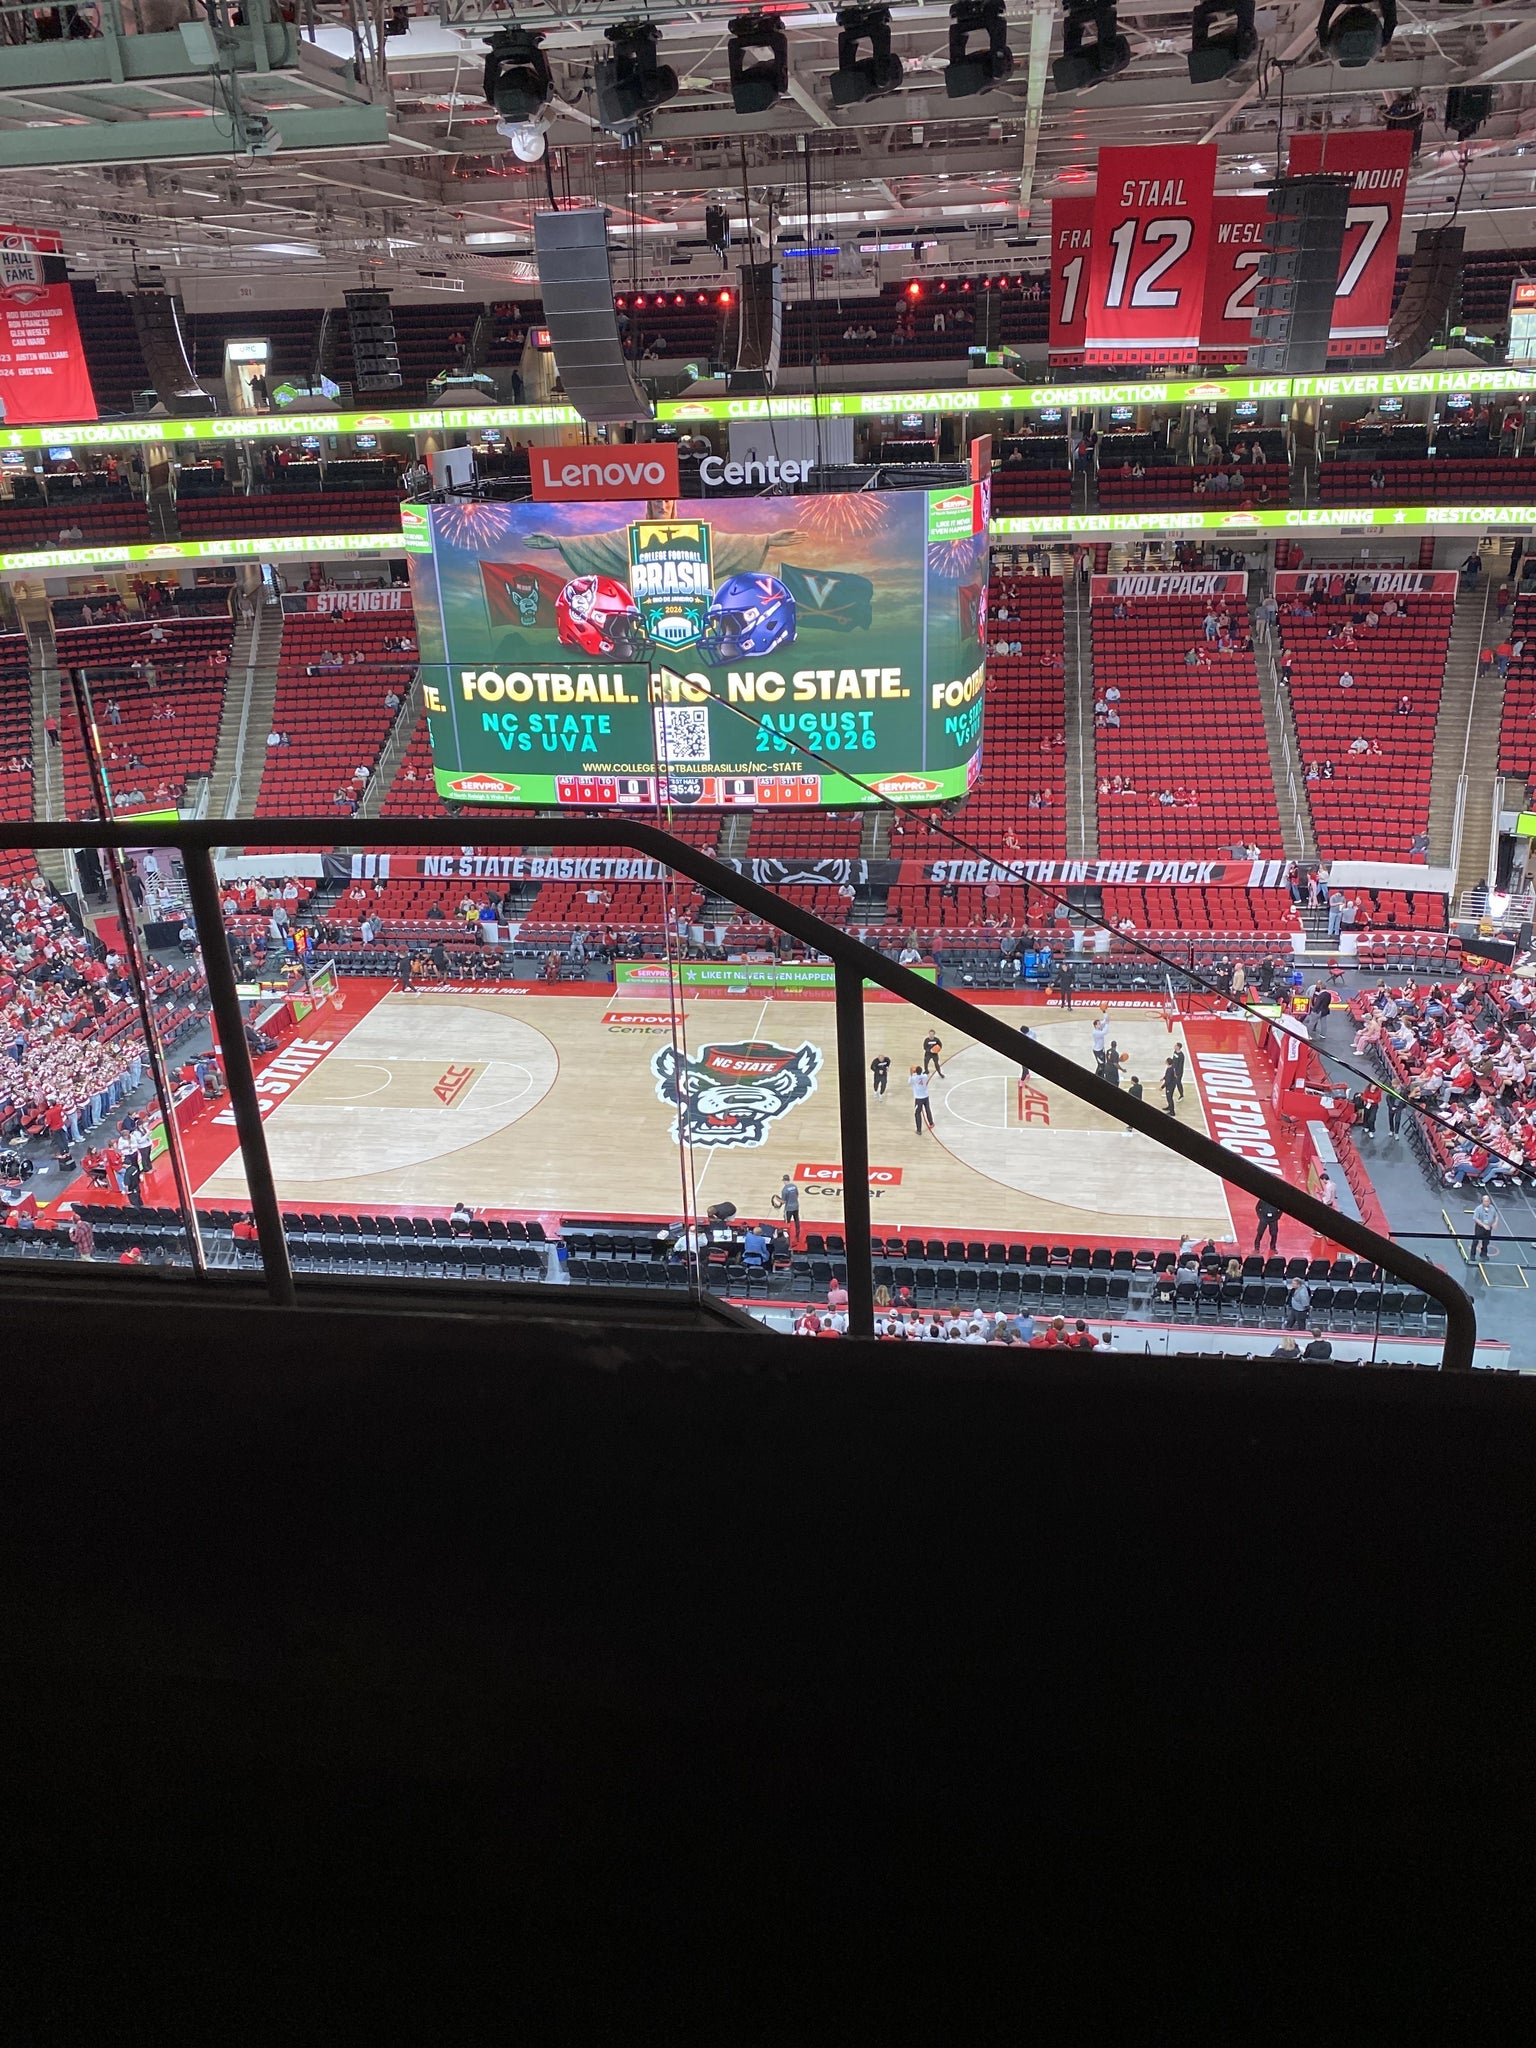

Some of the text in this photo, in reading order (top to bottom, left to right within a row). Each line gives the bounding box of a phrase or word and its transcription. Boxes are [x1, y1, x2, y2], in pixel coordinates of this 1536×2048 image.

[1120, 180, 1187, 207] STAAL
[1058, 228, 1091, 249] FRA
[1218, 223, 1262, 243] WESL
[2, 252, 32, 265] HALL
[1334, 203, 1390, 297] 7
[1105, 217, 1194, 308] 12
[6, 268, 35, 283] FAME
[18, 368, 34, 376] ERIC
[34, 367, 54, 375] STAAL
[728, 399, 812, 416] CLEANING
[861, 393, 980, 412] RESTORATION
[1031, 385, 1168, 407] CONSTRUCTION
[1248, 380, 1289, 397] LIKE
[1294, 378, 1311, 395] IT
[1316, 377, 1378, 394] NEVER
[1383, 374, 1433, 392] EVEN
[1438, 369, 1536, 390] HAPPENE
[40, 424, 163, 445] RESTORATION
[212, 415, 339, 435] CONSTRUCTION
[410, 413, 442, 428] LIKE
[450, 411, 462, 427] IT
[467, 409, 519, 426] NEVER
[523, 406, 567, 424] EVEN
[543, 455, 814, 488] Lenovo Center
[1010, 517, 1064, 532] NEVER
[1068, 515, 1111, 530] EVEN
[1113, 513, 1204, 529] HAPPENED
[1286, 509, 1374, 525] CLEANING
[1426, 507, 1536, 523] RESTORATIO
[4, 547, 129, 570] CONSTRUCTION
[200, 541, 230, 556] LIKE
[232, 540, 246, 555] IT
[255, 538, 302, 553] NEVER
[305, 536, 345, 550] EVEN
[639, 550, 702, 563] COLLEGE FOOTBALL
[632, 561, 714, 598] BRASIL
[1115, 574, 1221, 597] WOLFPACK
[317, 590, 401, 612] STRENGTH
[461, 671, 639, 703] FOOTBALL.
[727, 671, 786, 702] NC
[792, 667, 911, 701] STATE.
[482, 713, 611, 734] NC STATE
[758, 711, 874, 733] AUGUST
[944, 713, 967, 734] NC
[498, 732, 598, 752] VS UVA
[756, 730, 877, 755] 29, 2026
[955, 727, 970, 747] VS
[461, 781, 504, 791] SERVPRO
[564, 788, 610, 797] 0 0 0
[628, 779, 639, 794] 0
[670, 785, 701, 795] 35:42
[734, 780, 745, 794] 0
[764, 789, 771, 798] 0
[785, 789, 792, 797] 0
[805, 788, 812, 797] 0
[877, 781, 927, 792] SERVPRO
[424, 857, 668, 881] NC STATE BASKETBALL
[931, 860, 1214, 883] STRENGTH IN THE PACK
[701, 971, 835, 981] LIKE IT NEVER EVEN HAPPEN
[1295, 1003, 1306, 1012] 30
[609, 1014, 680, 1023] Lenovo
[608, 1026, 672, 1034] Center
[253, 1037, 335, 1095] STATE
[712, 1056, 778, 1073] NC STATE
[432, 1064, 471, 1102] ACC
[1024, 1084, 1050, 1126] ACC
